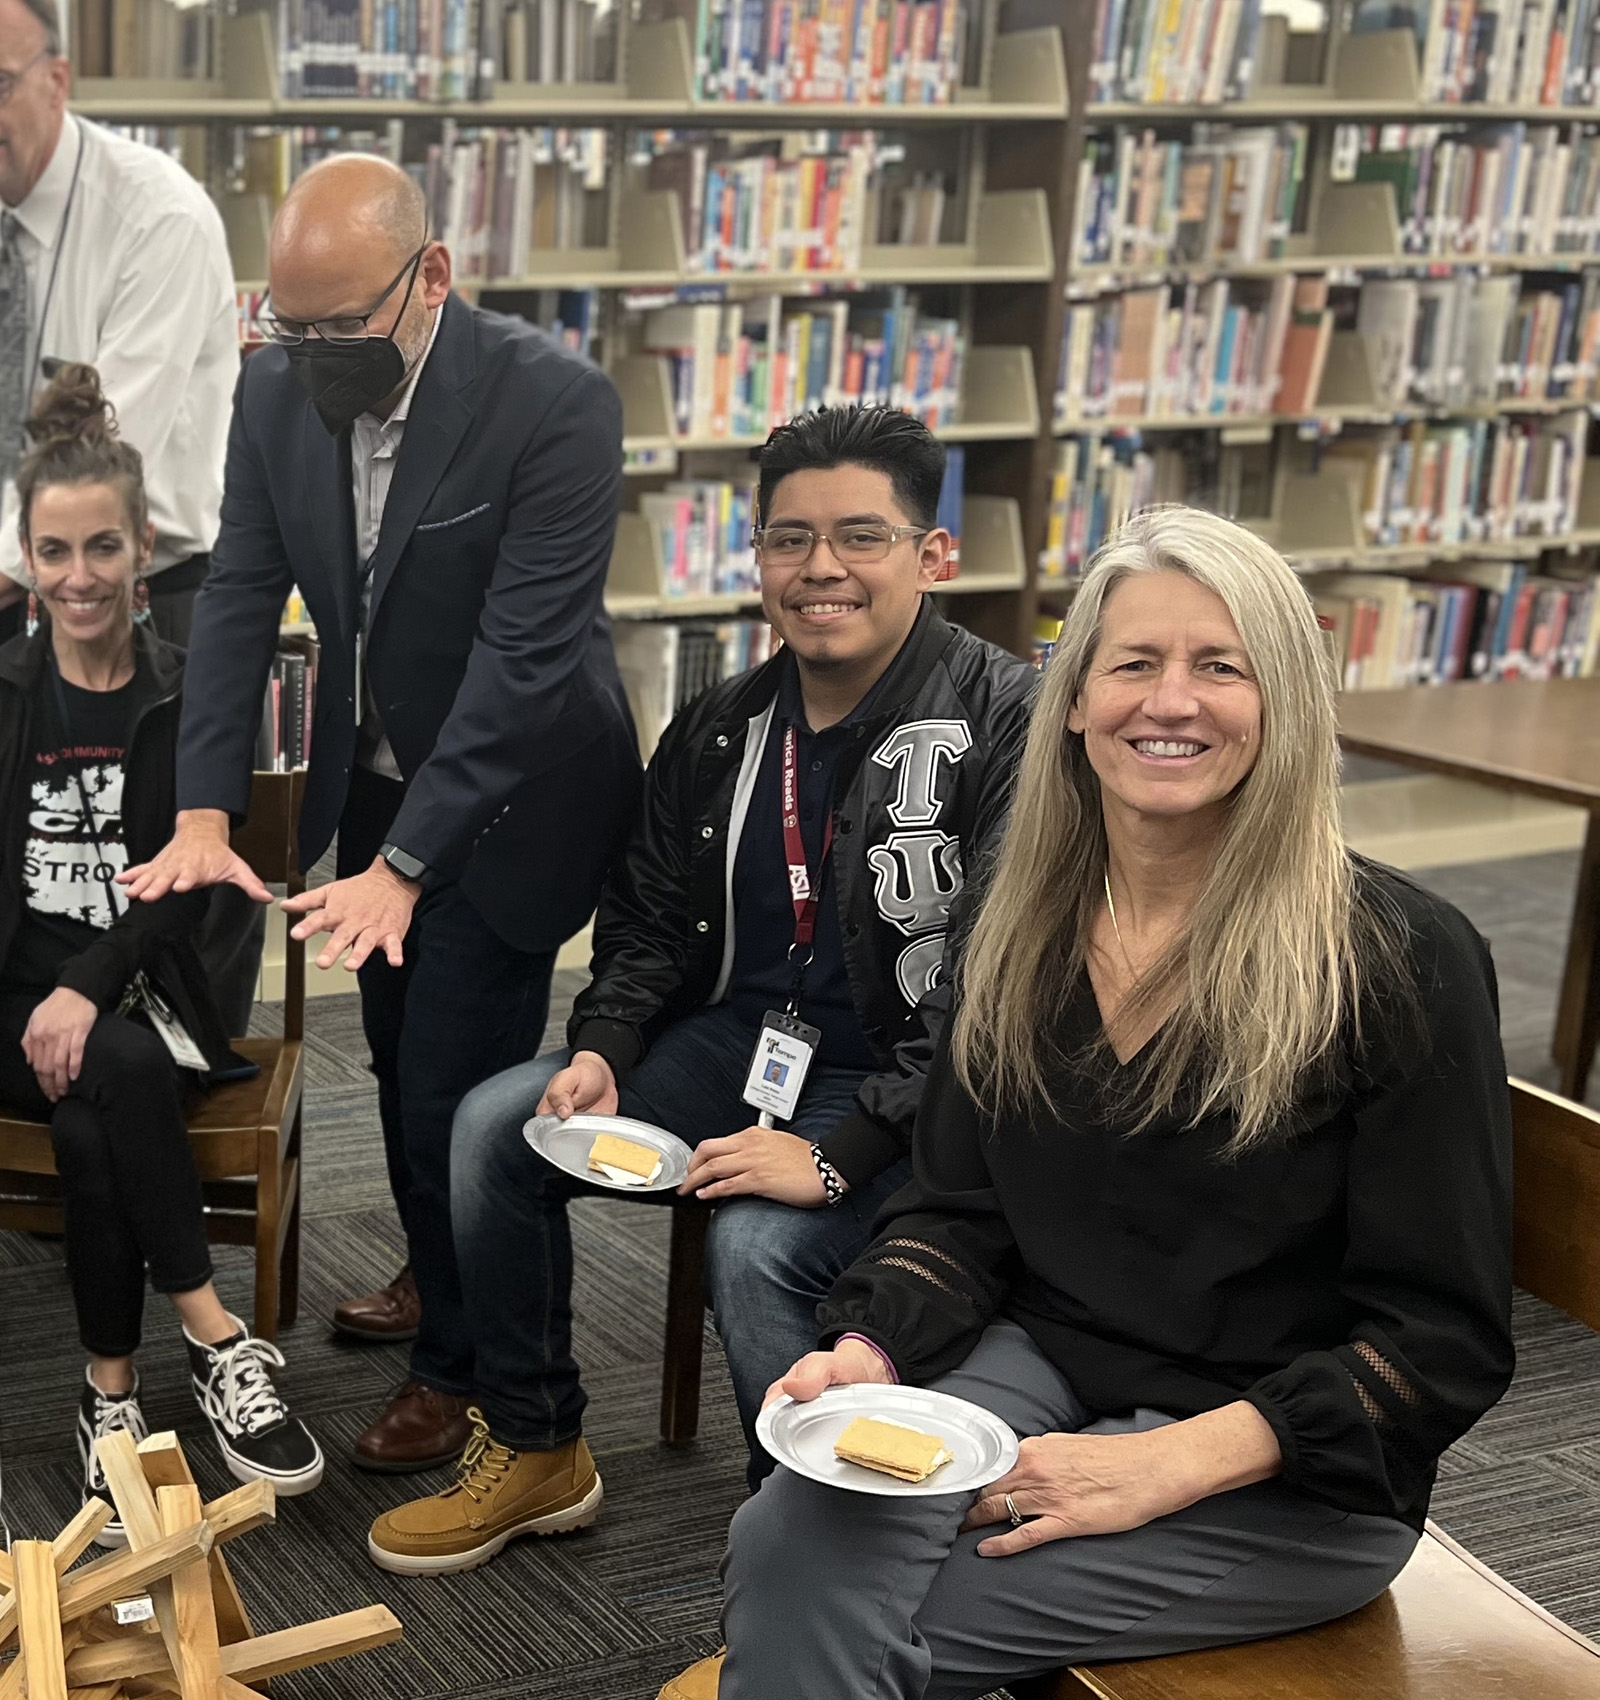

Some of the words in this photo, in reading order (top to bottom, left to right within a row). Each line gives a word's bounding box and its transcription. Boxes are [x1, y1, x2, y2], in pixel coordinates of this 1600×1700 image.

[784, 768, 796, 812] Reads
[22, 856, 118, 884] STRO
[788, 864, 811, 901] ASU
